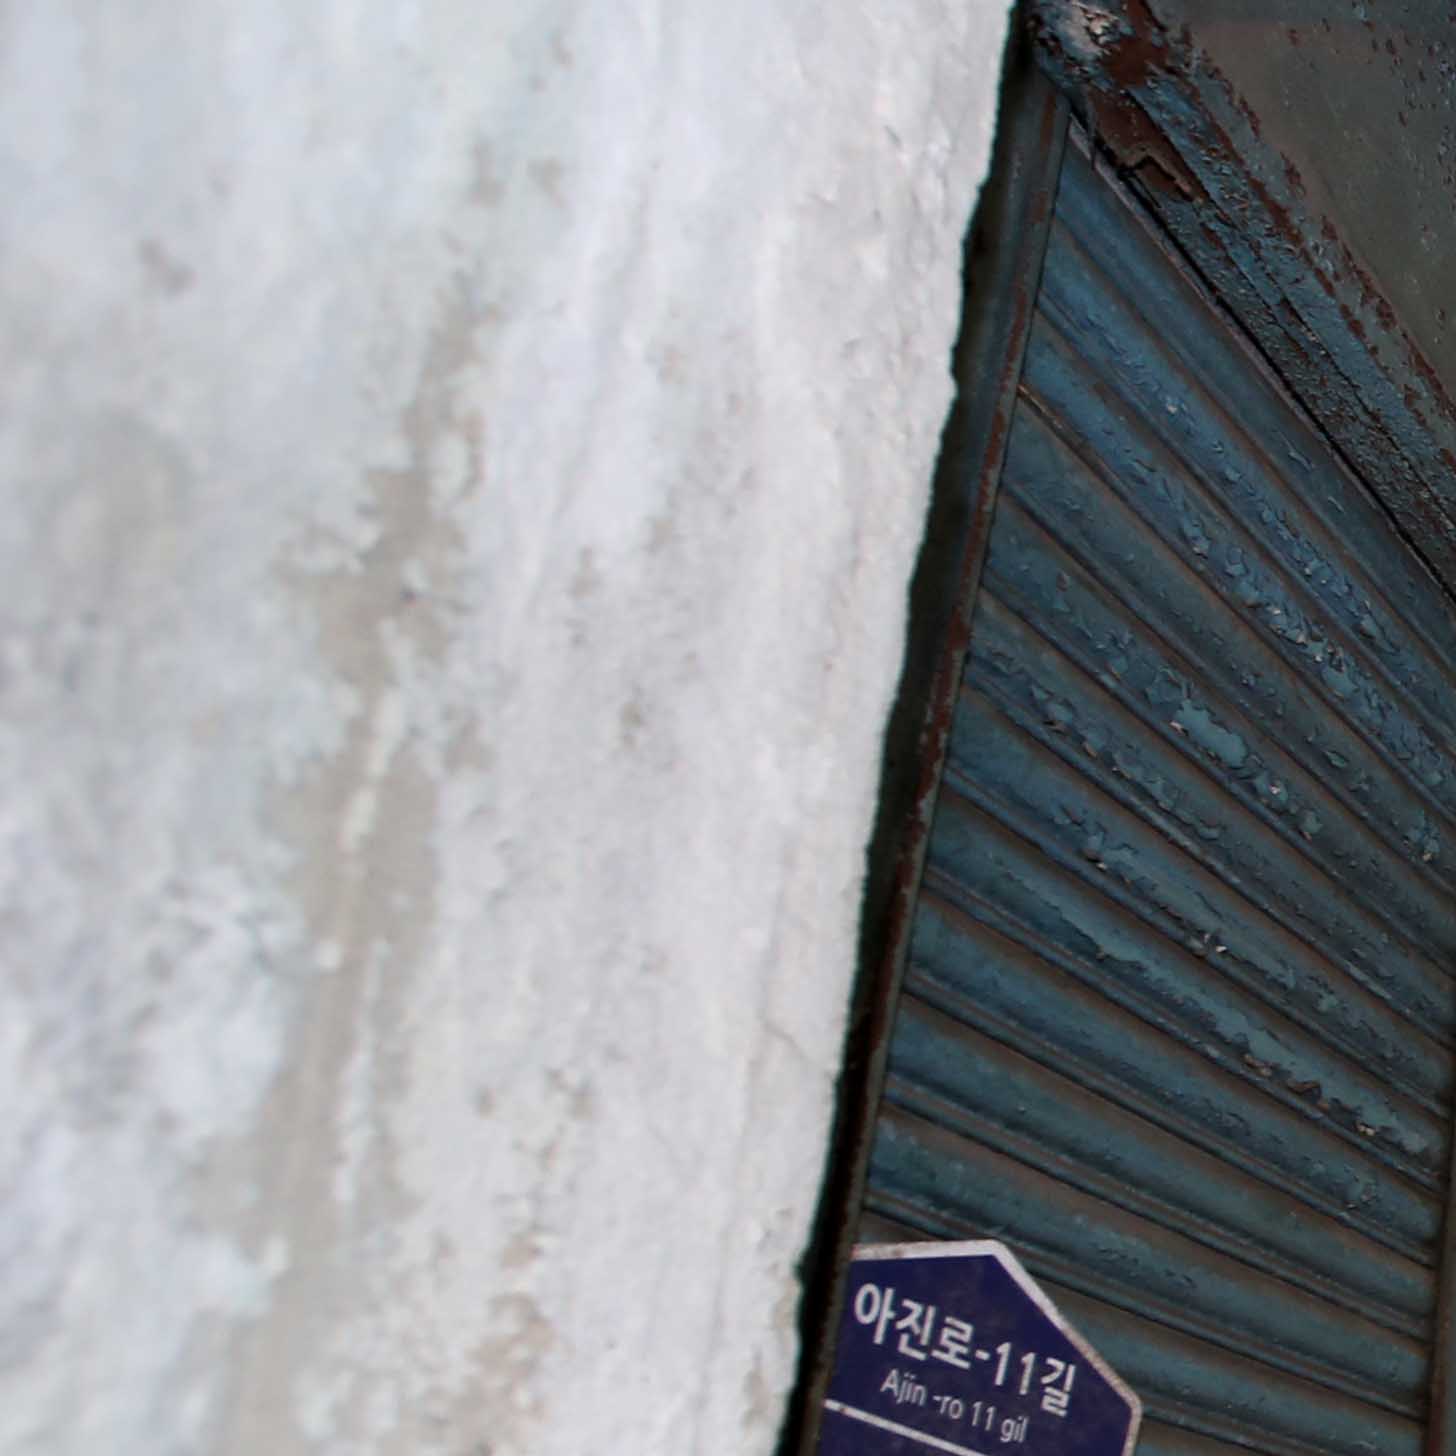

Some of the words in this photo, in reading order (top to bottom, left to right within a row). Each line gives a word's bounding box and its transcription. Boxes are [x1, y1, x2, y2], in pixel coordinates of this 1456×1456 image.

[853, 1281, 1077, 1417] 아진로-11길
[880, 1367, 927, 1407] Ajin
[970, 1401, 995, 1433] 11
[1000, 1414, 1030, 1443] gil
